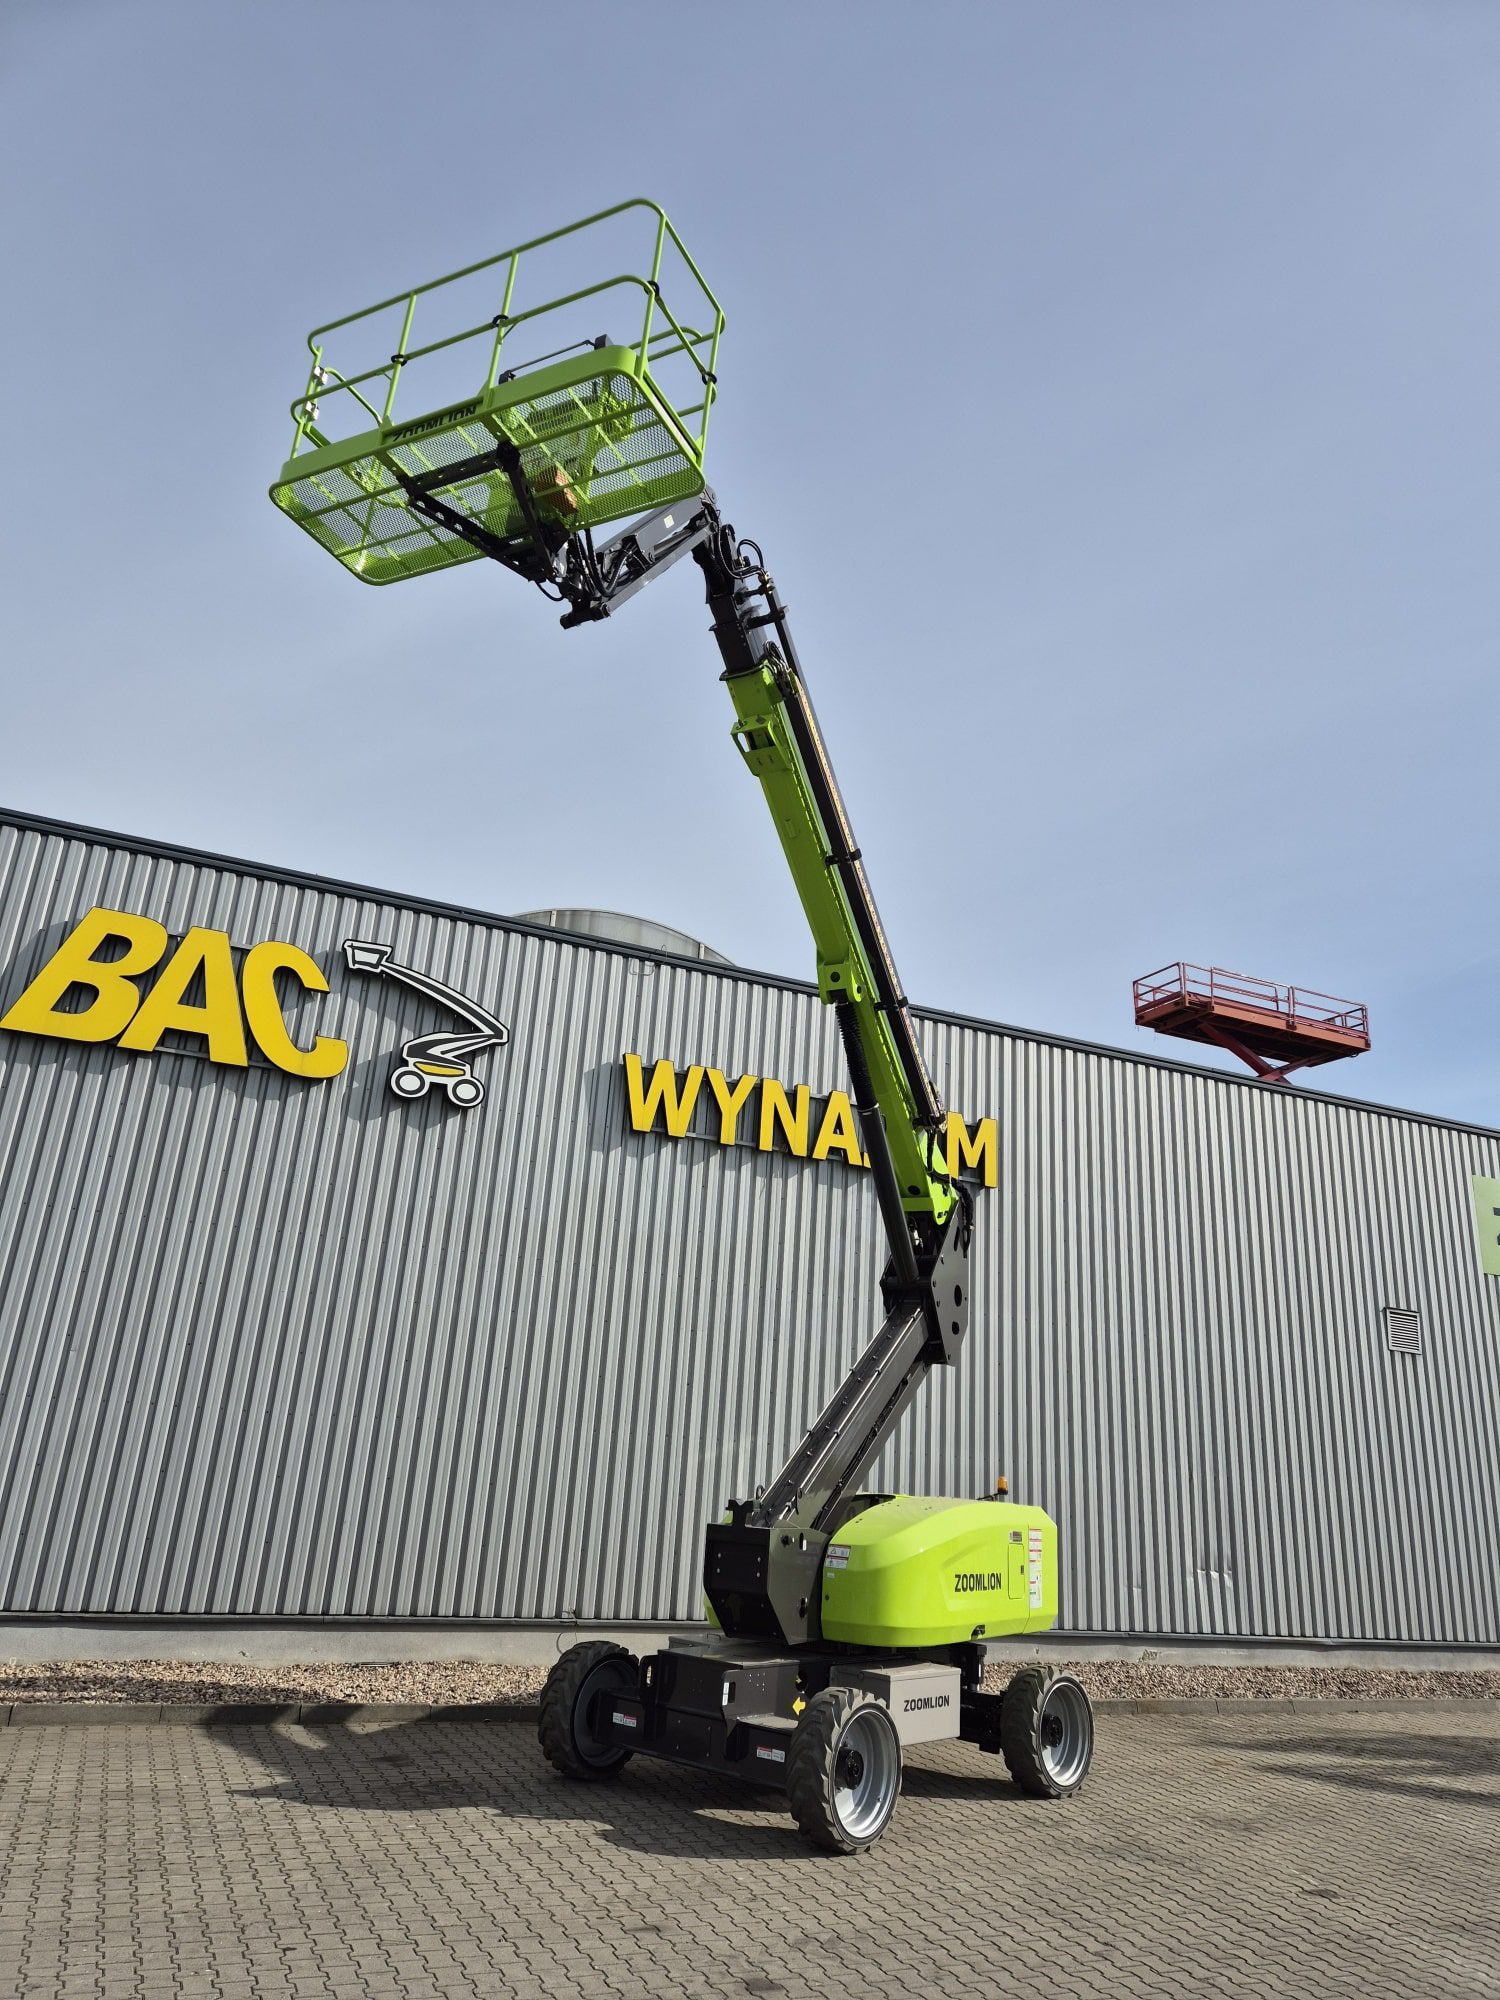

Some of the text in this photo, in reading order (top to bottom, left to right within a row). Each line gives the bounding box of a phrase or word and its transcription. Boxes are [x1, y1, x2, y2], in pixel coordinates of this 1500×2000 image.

[0, 906, 349, 1079] BAC
[623, 1052, 998, 1189] WYNAM
[954, 1572, 1002, 1593] ZOOMLION
[903, 1695, 950, 1712] ZOOMLION
